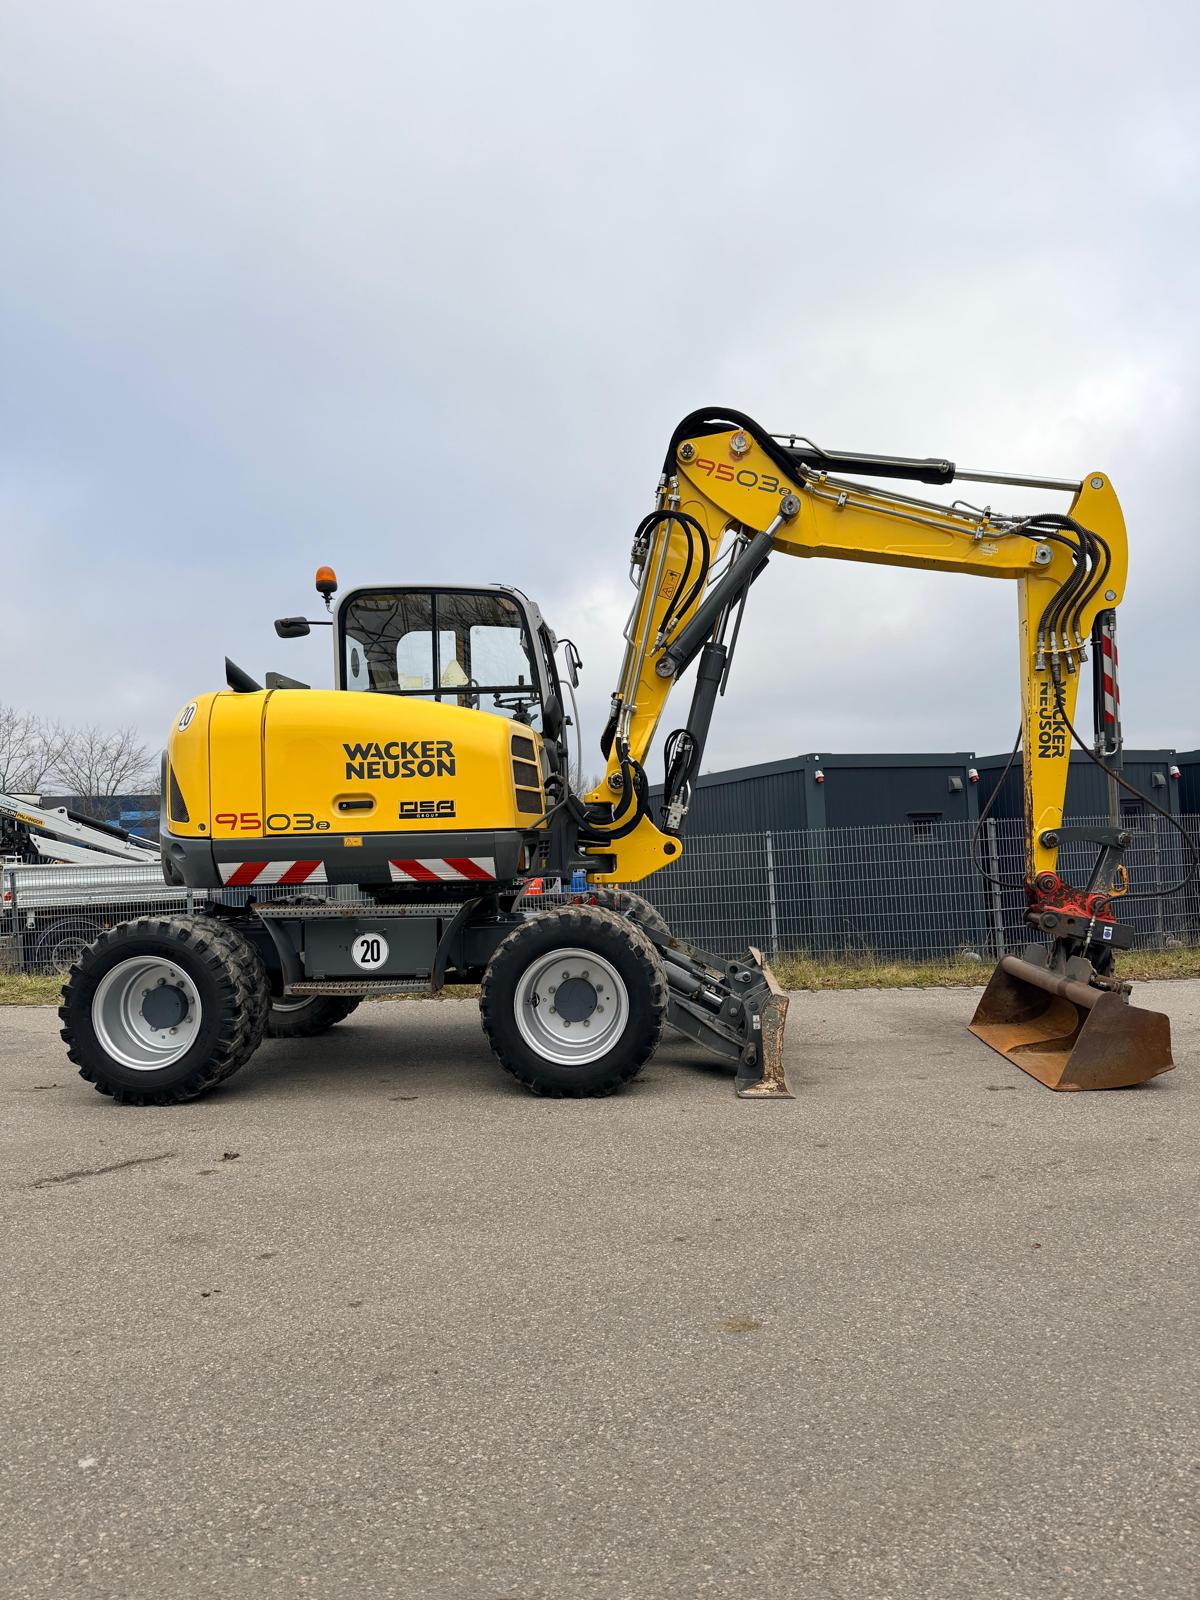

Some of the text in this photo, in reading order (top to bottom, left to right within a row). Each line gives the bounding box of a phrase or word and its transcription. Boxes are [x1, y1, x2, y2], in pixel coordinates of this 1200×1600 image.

[179, 706, 195, 727] 20
[1038, 681, 1052, 759] NEUSON
[342, 740, 455, 760] WACKER
[345, 759, 456, 780] NEUSON
[0, 807, 17, 816] SILON
[360, 938, 381, 963] 20
